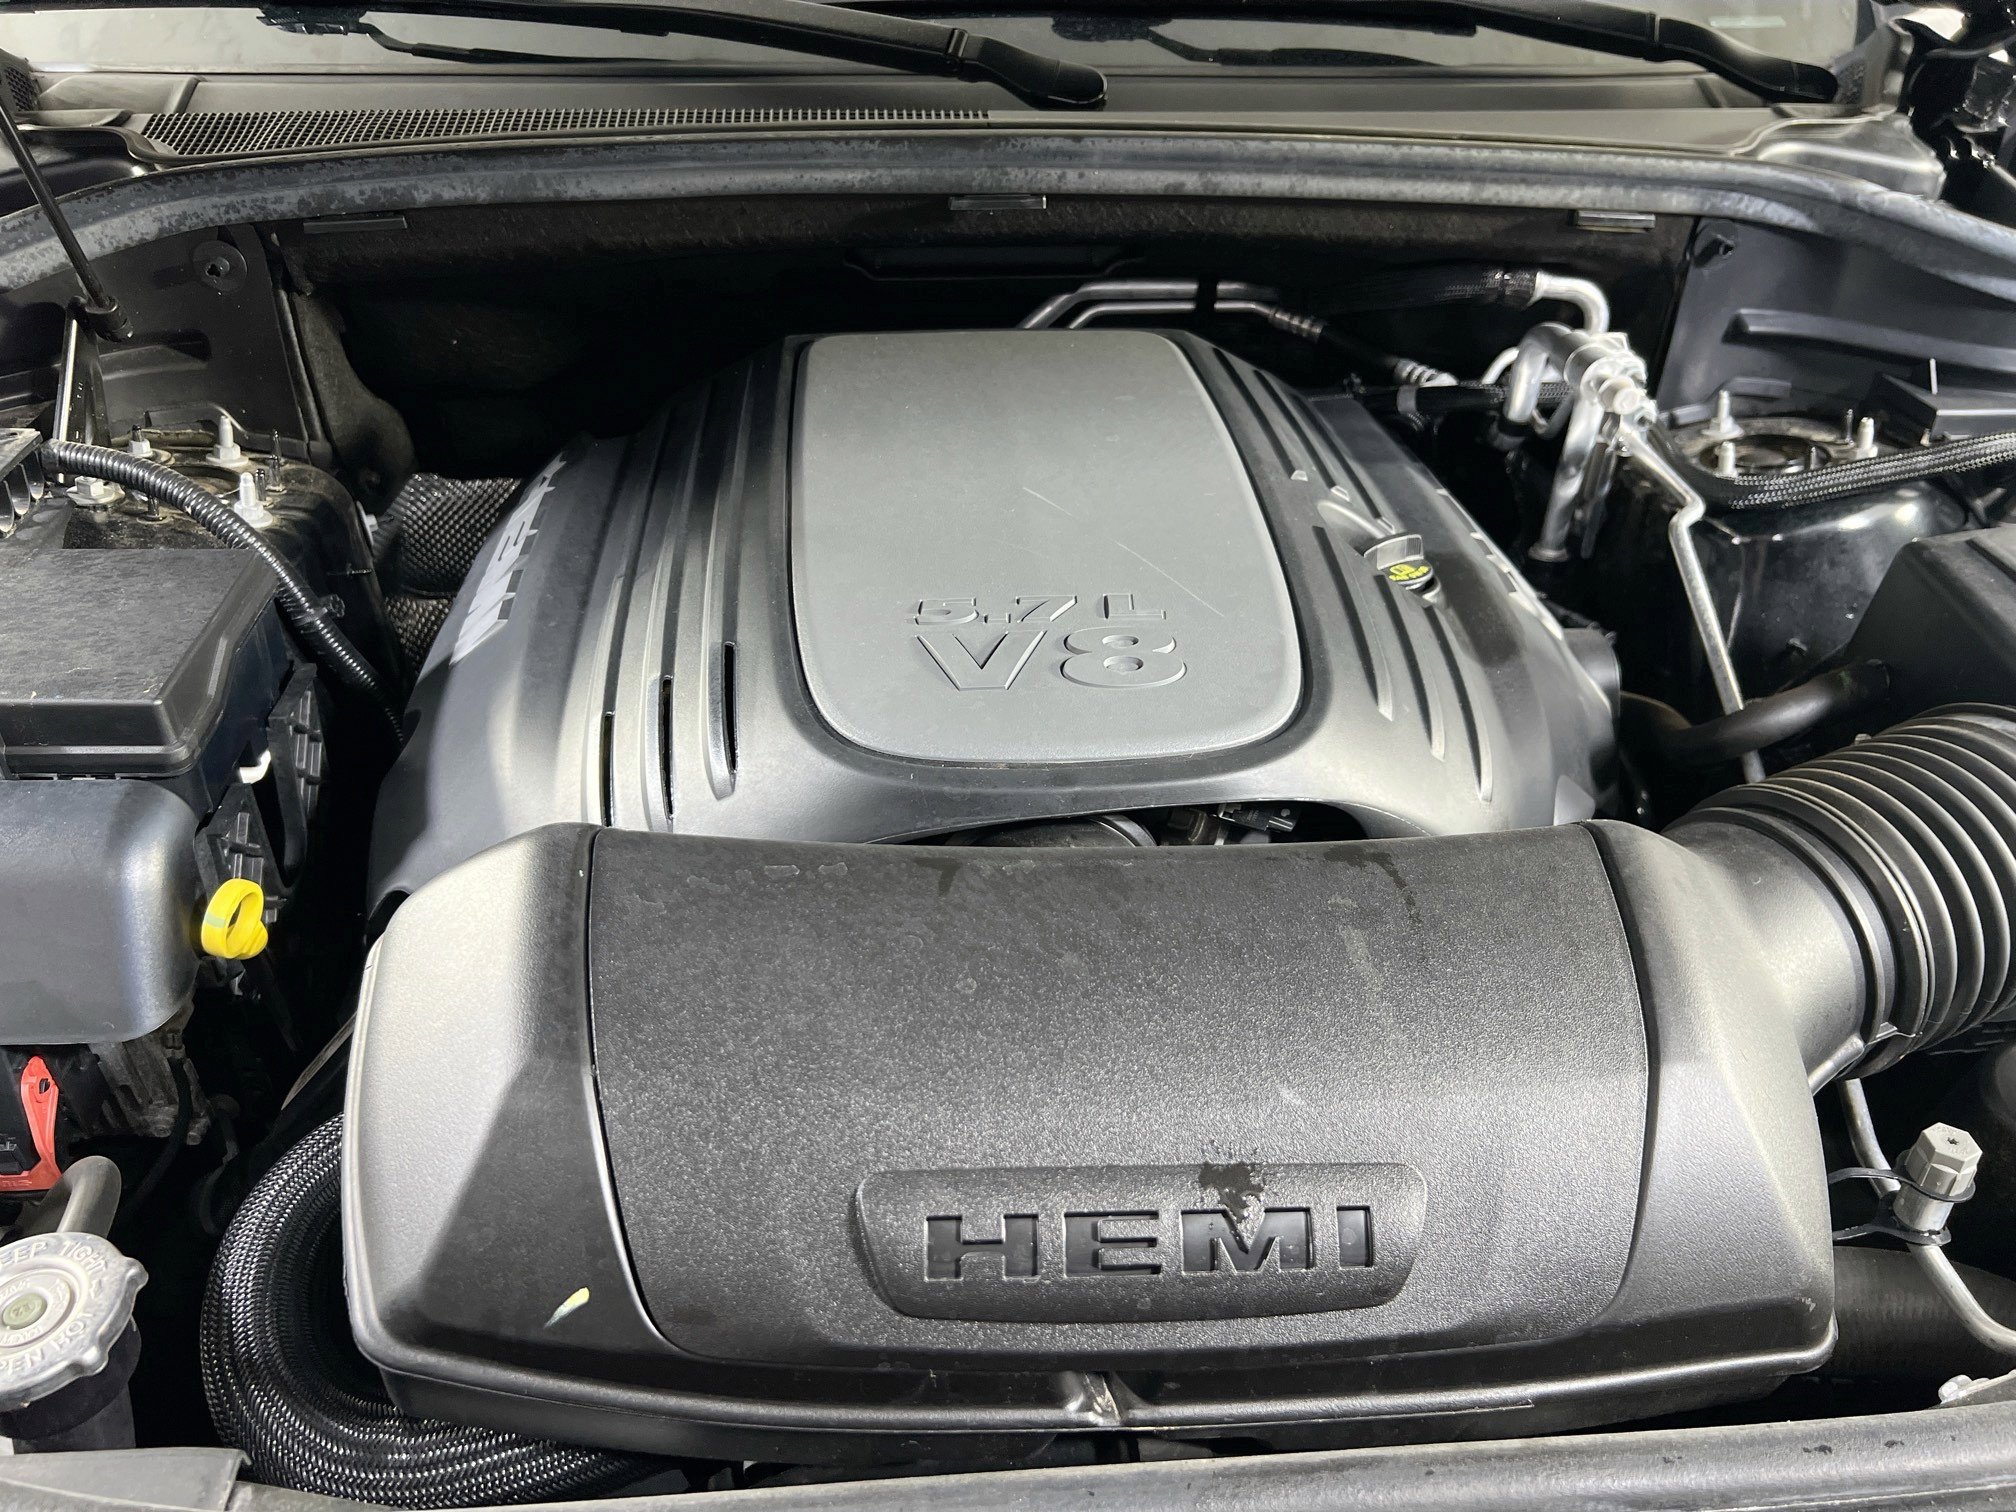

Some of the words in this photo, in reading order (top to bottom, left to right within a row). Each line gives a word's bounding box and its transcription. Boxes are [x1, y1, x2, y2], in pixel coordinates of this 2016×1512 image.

[914, 625, 1188, 691] V8
[0, 1241, 48, 1272] EEP
[924, 1206, 1375, 1282] HEMI
